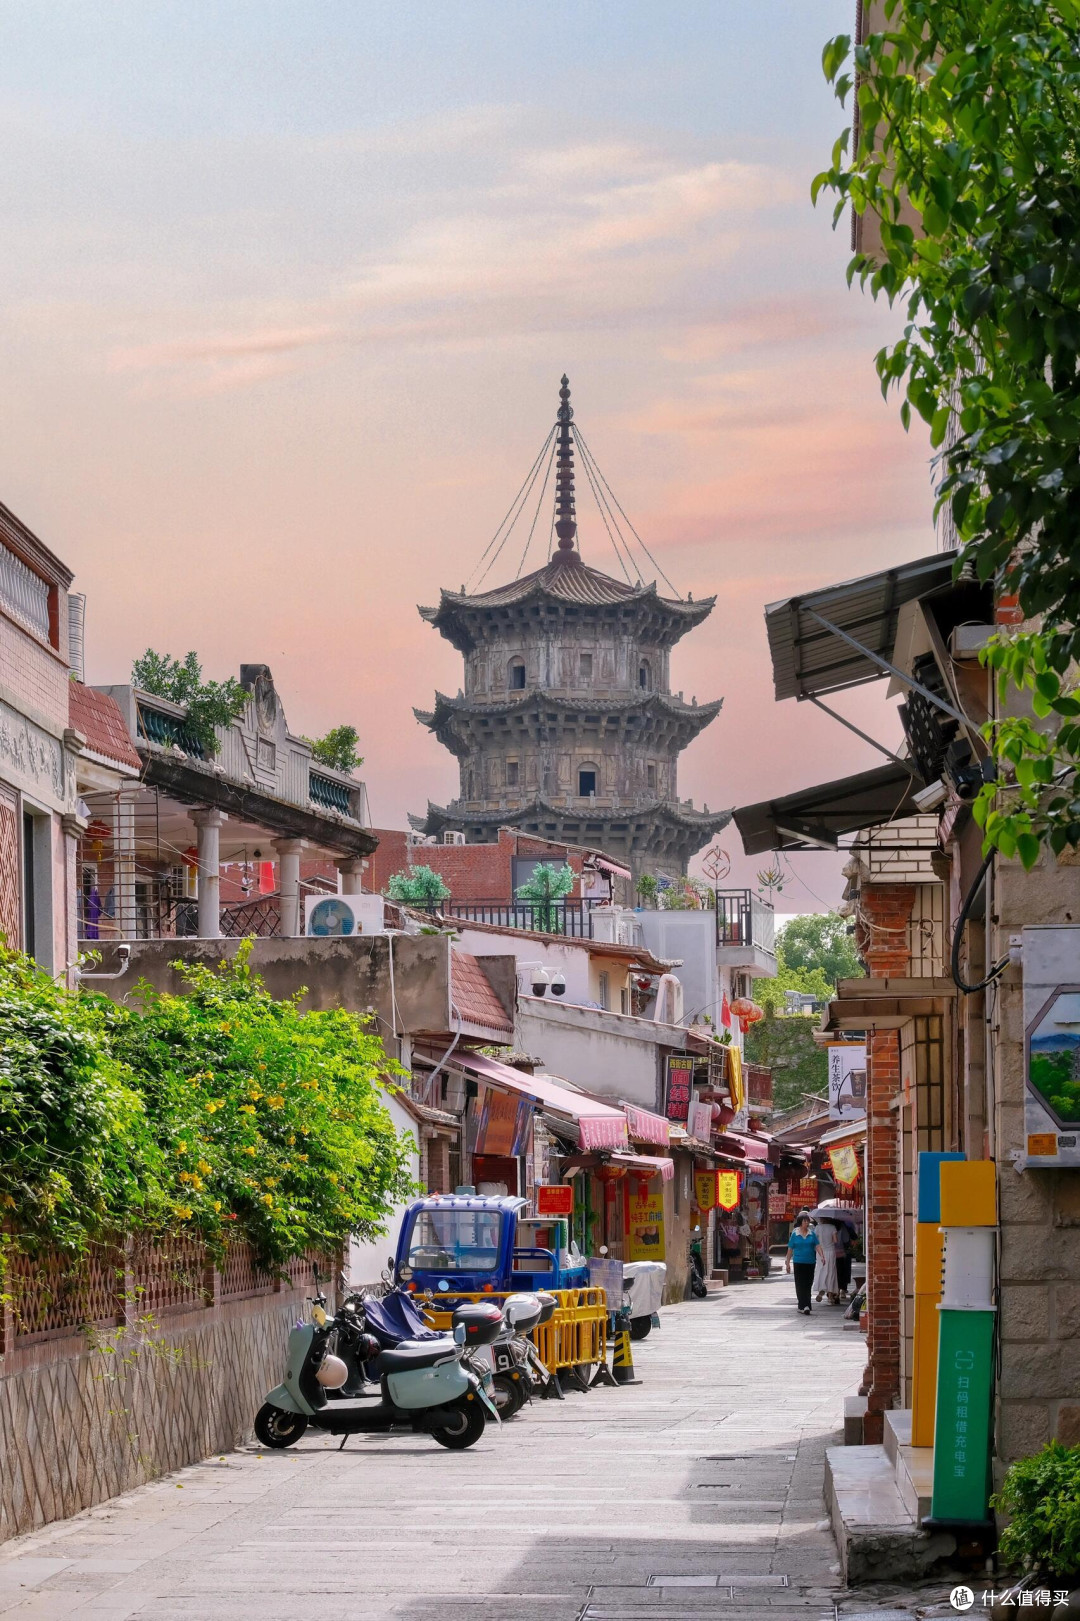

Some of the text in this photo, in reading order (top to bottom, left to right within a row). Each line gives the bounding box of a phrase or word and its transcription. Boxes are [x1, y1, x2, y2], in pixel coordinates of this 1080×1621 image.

[667, 1069, 690, 1119] 面线糊
[831, 1055, 840, 1092] 养生茶饮
[954, 1376, 970, 1477] 扫码租借充电宝
